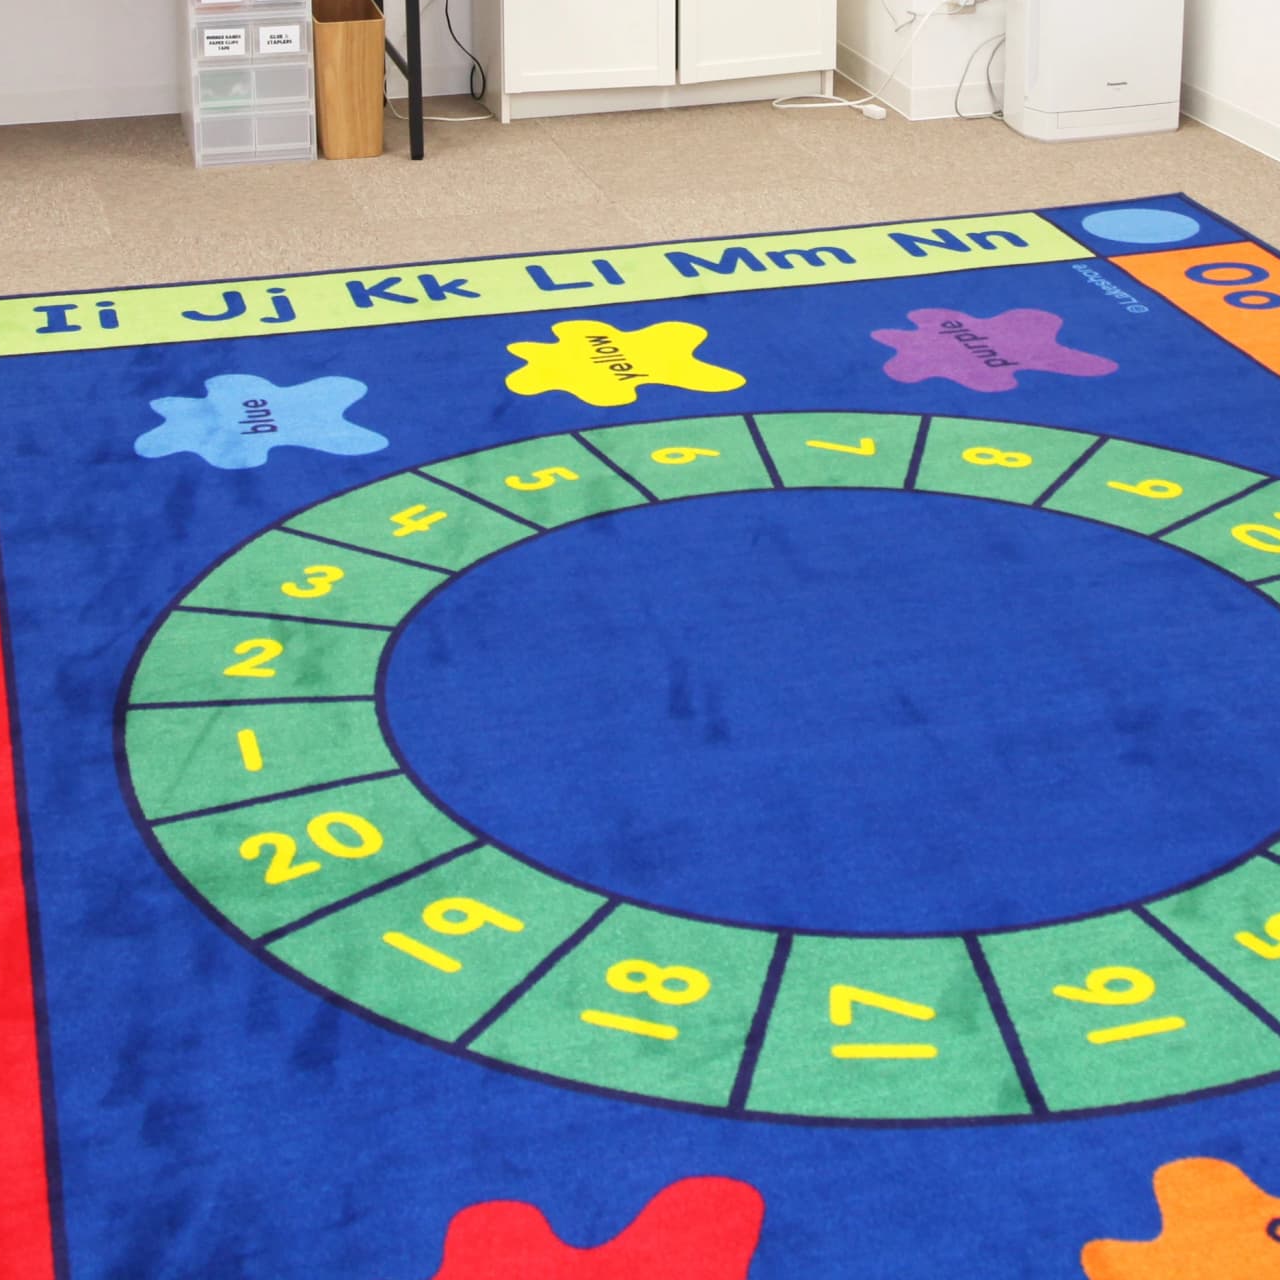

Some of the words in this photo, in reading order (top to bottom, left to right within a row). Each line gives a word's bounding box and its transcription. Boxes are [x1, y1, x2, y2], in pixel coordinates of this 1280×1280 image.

[35, 302, 118, 333] Ii
[182, 287, 296, 324] Jj
[347, 275, 479, 307] Kk
[527, 260, 624, 291] Ll
[666, 247, 855, 277] Mm
[890, 229, 1027, 256] Nn
[589, 335, 648, 381] yellow
[941, 319, 1019, 368] purple
[240, 400, 276, 434] blue
[652, 448, 719, 464] 6
[807, 438, 874, 455] 7
[963, 448, 1031, 467] 8
[506, 468, 578, 490] 5
[1108, 480, 1182, 498] 9
[391, 505, 446, 536] 4
[282, 566, 343, 597] 3
[224, 639, 282, 677] 2
[238, 730, 262, 771] 1
[240, 812, 382, 883] 20
[384, 898, 523, 972] 19
[582, 960, 710, 1039] 18
[1054, 967, 1185, 1043] 16
[830, 985, 936, 1058] 17
